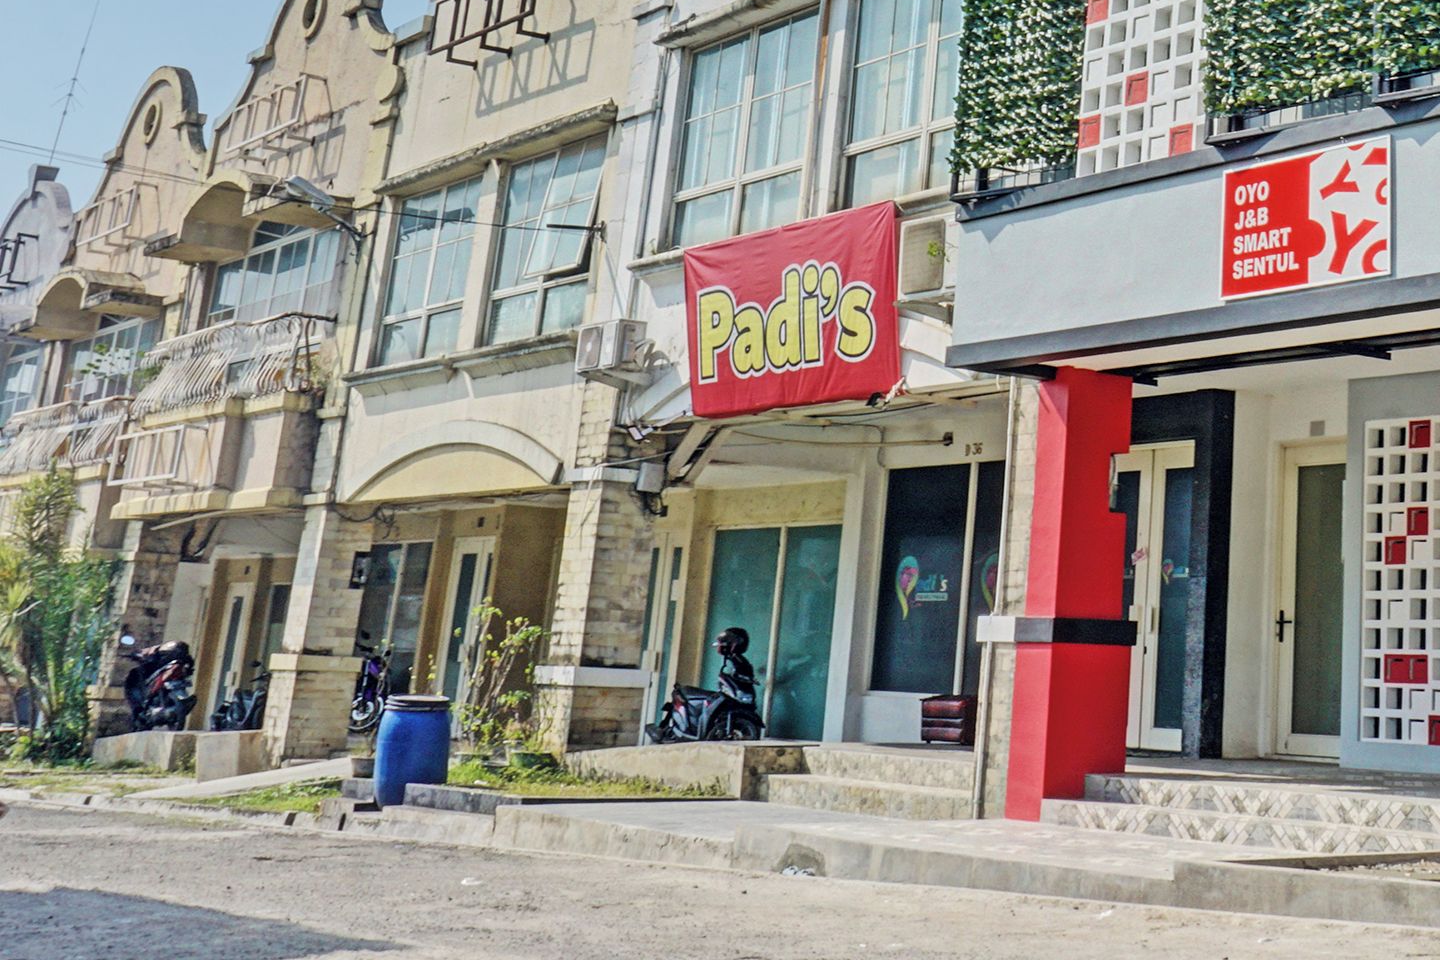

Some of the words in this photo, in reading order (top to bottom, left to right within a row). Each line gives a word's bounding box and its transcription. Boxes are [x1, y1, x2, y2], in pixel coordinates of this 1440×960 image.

[1234, 180, 1270, 206] OYO
[1234, 206, 1269, 230] J&B
[1233, 227, 1292, 255] SMART
[1232, 251, 1299, 280] SENTUL
[697, 259, 876, 385] Padi's
